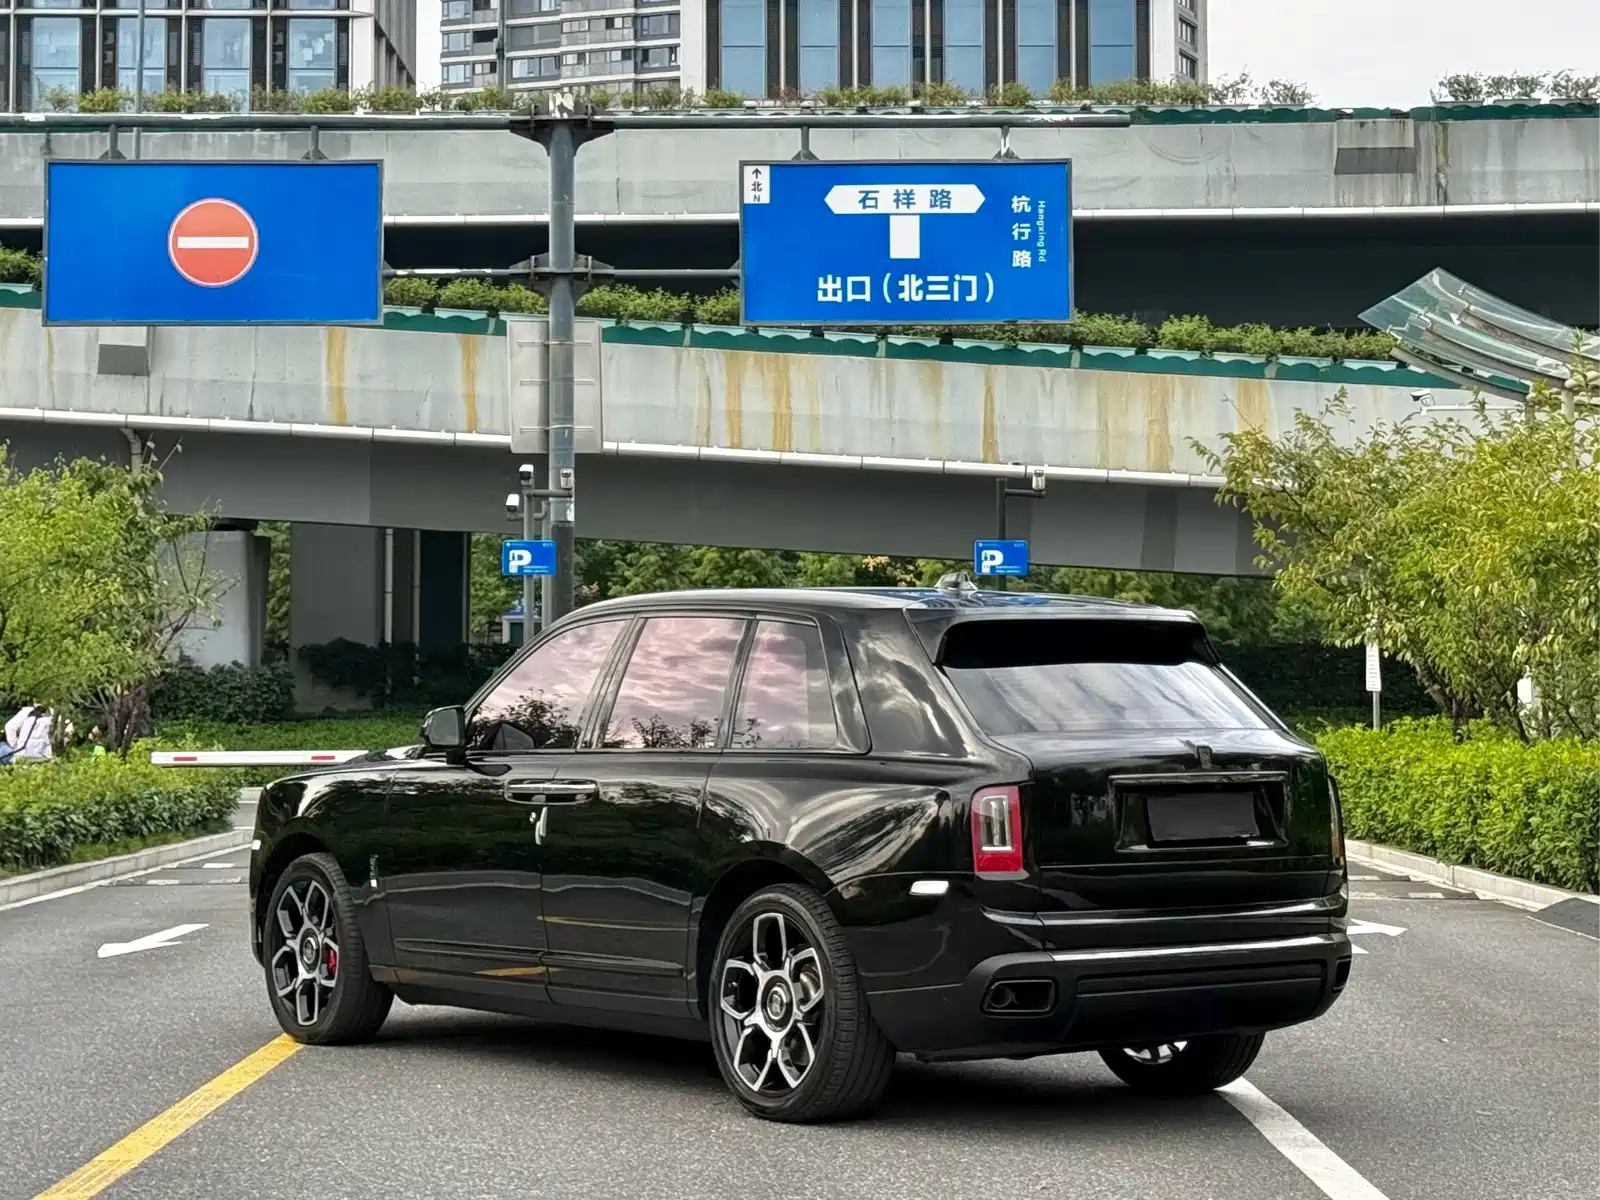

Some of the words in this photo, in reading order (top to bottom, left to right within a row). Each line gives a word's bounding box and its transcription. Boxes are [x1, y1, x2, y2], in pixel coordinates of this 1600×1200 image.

[751, 181, 763, 192] 北
[753, 194, 761, 203] N
[858, 189, 952, 210] 石祥路
[1011, 195, 1032, 269] 杭行路
[1036, 200, 1046, 247] Hangxing
[1038, 249, 1047, 262] Rd
[817, 272, 995, 303] 出口（北三门）
[508, 549, 532, 574] P
[981, 549, 1004, 574] P
